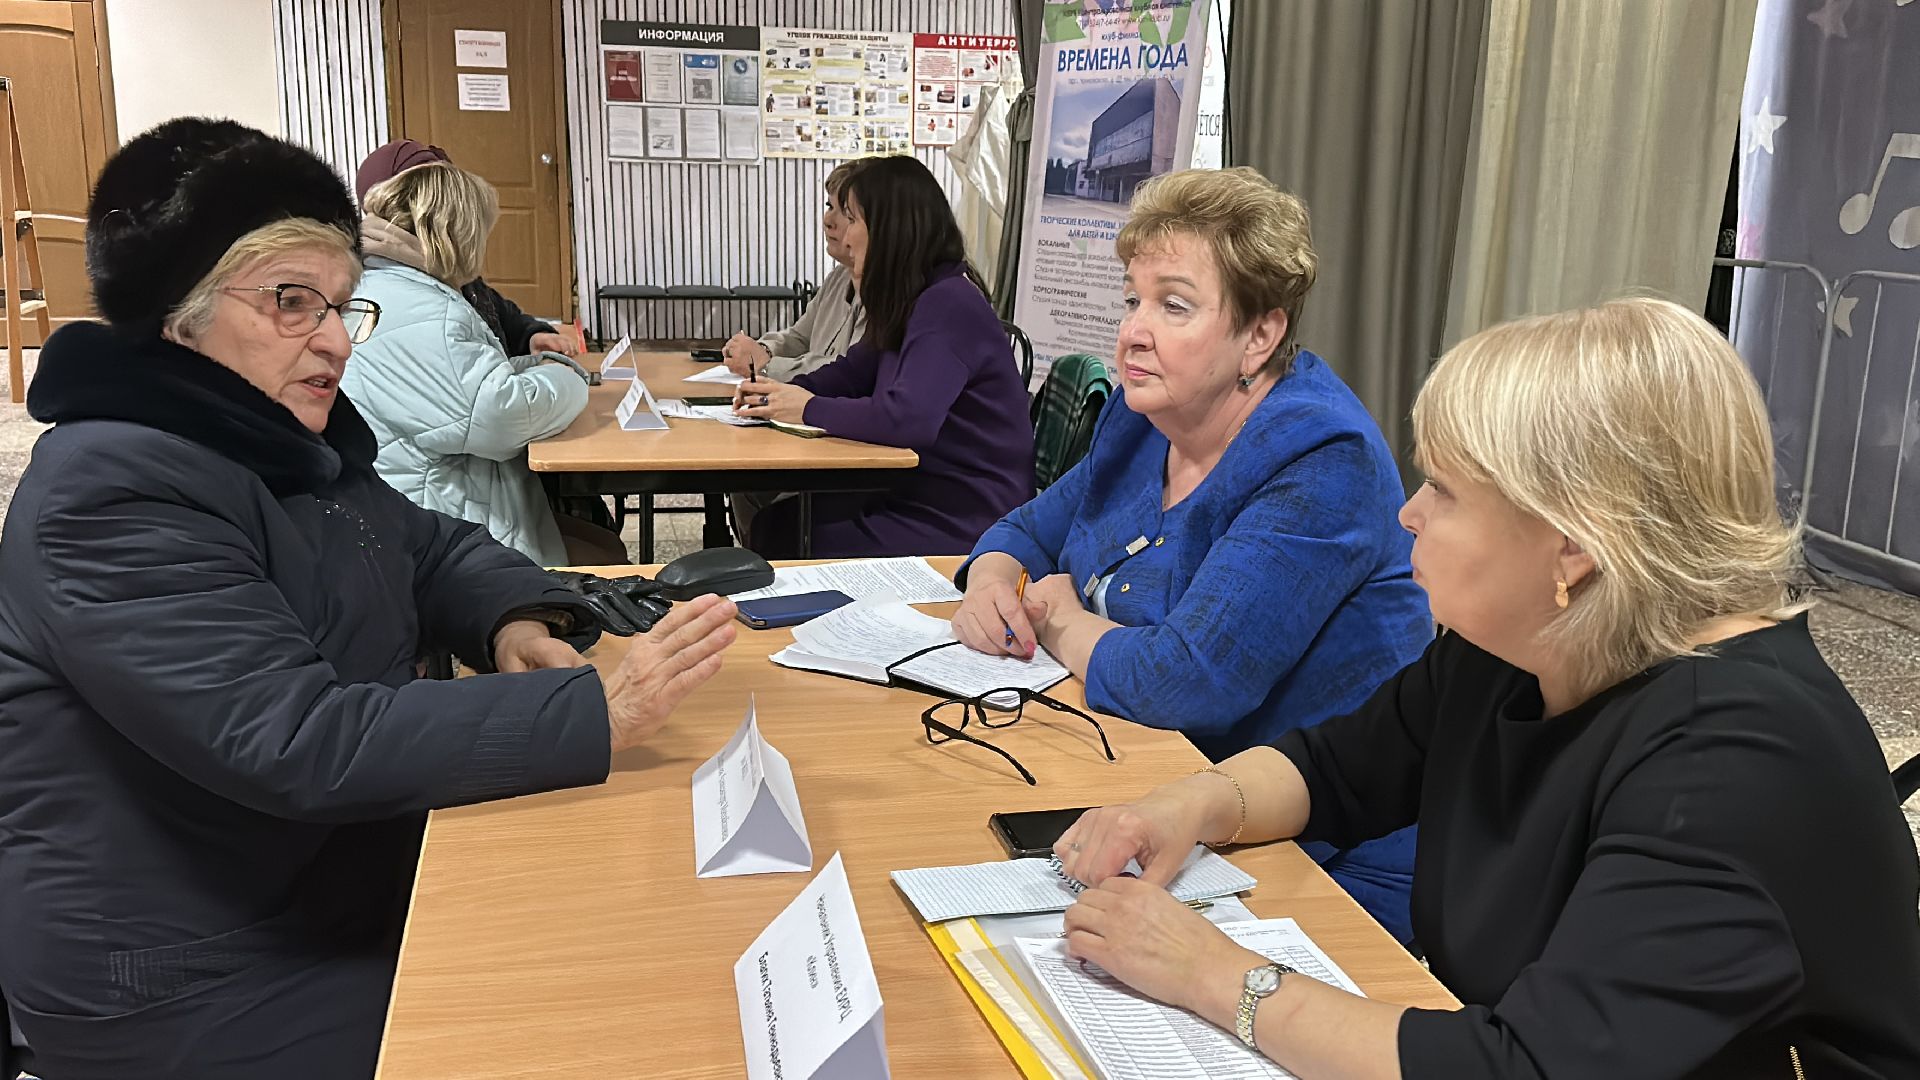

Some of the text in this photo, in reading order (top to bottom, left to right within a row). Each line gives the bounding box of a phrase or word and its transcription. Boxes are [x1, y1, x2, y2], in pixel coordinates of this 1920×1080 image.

[638, 28, 724, 44] ИНФОРМАЦИЯ
[937, 35, 1017, 48] АНТИТЕРРО
[1057, 42, 1188, 71] ВРЕМЕНА ГОДА
[1197, 110, 1221, 137] ЁТСЯ
[824, 934, 843, 993] Управления
[835, 987, 852, 1024] ЕИРЦ
[767, 1017, 783, 1080] Геннадьевн
